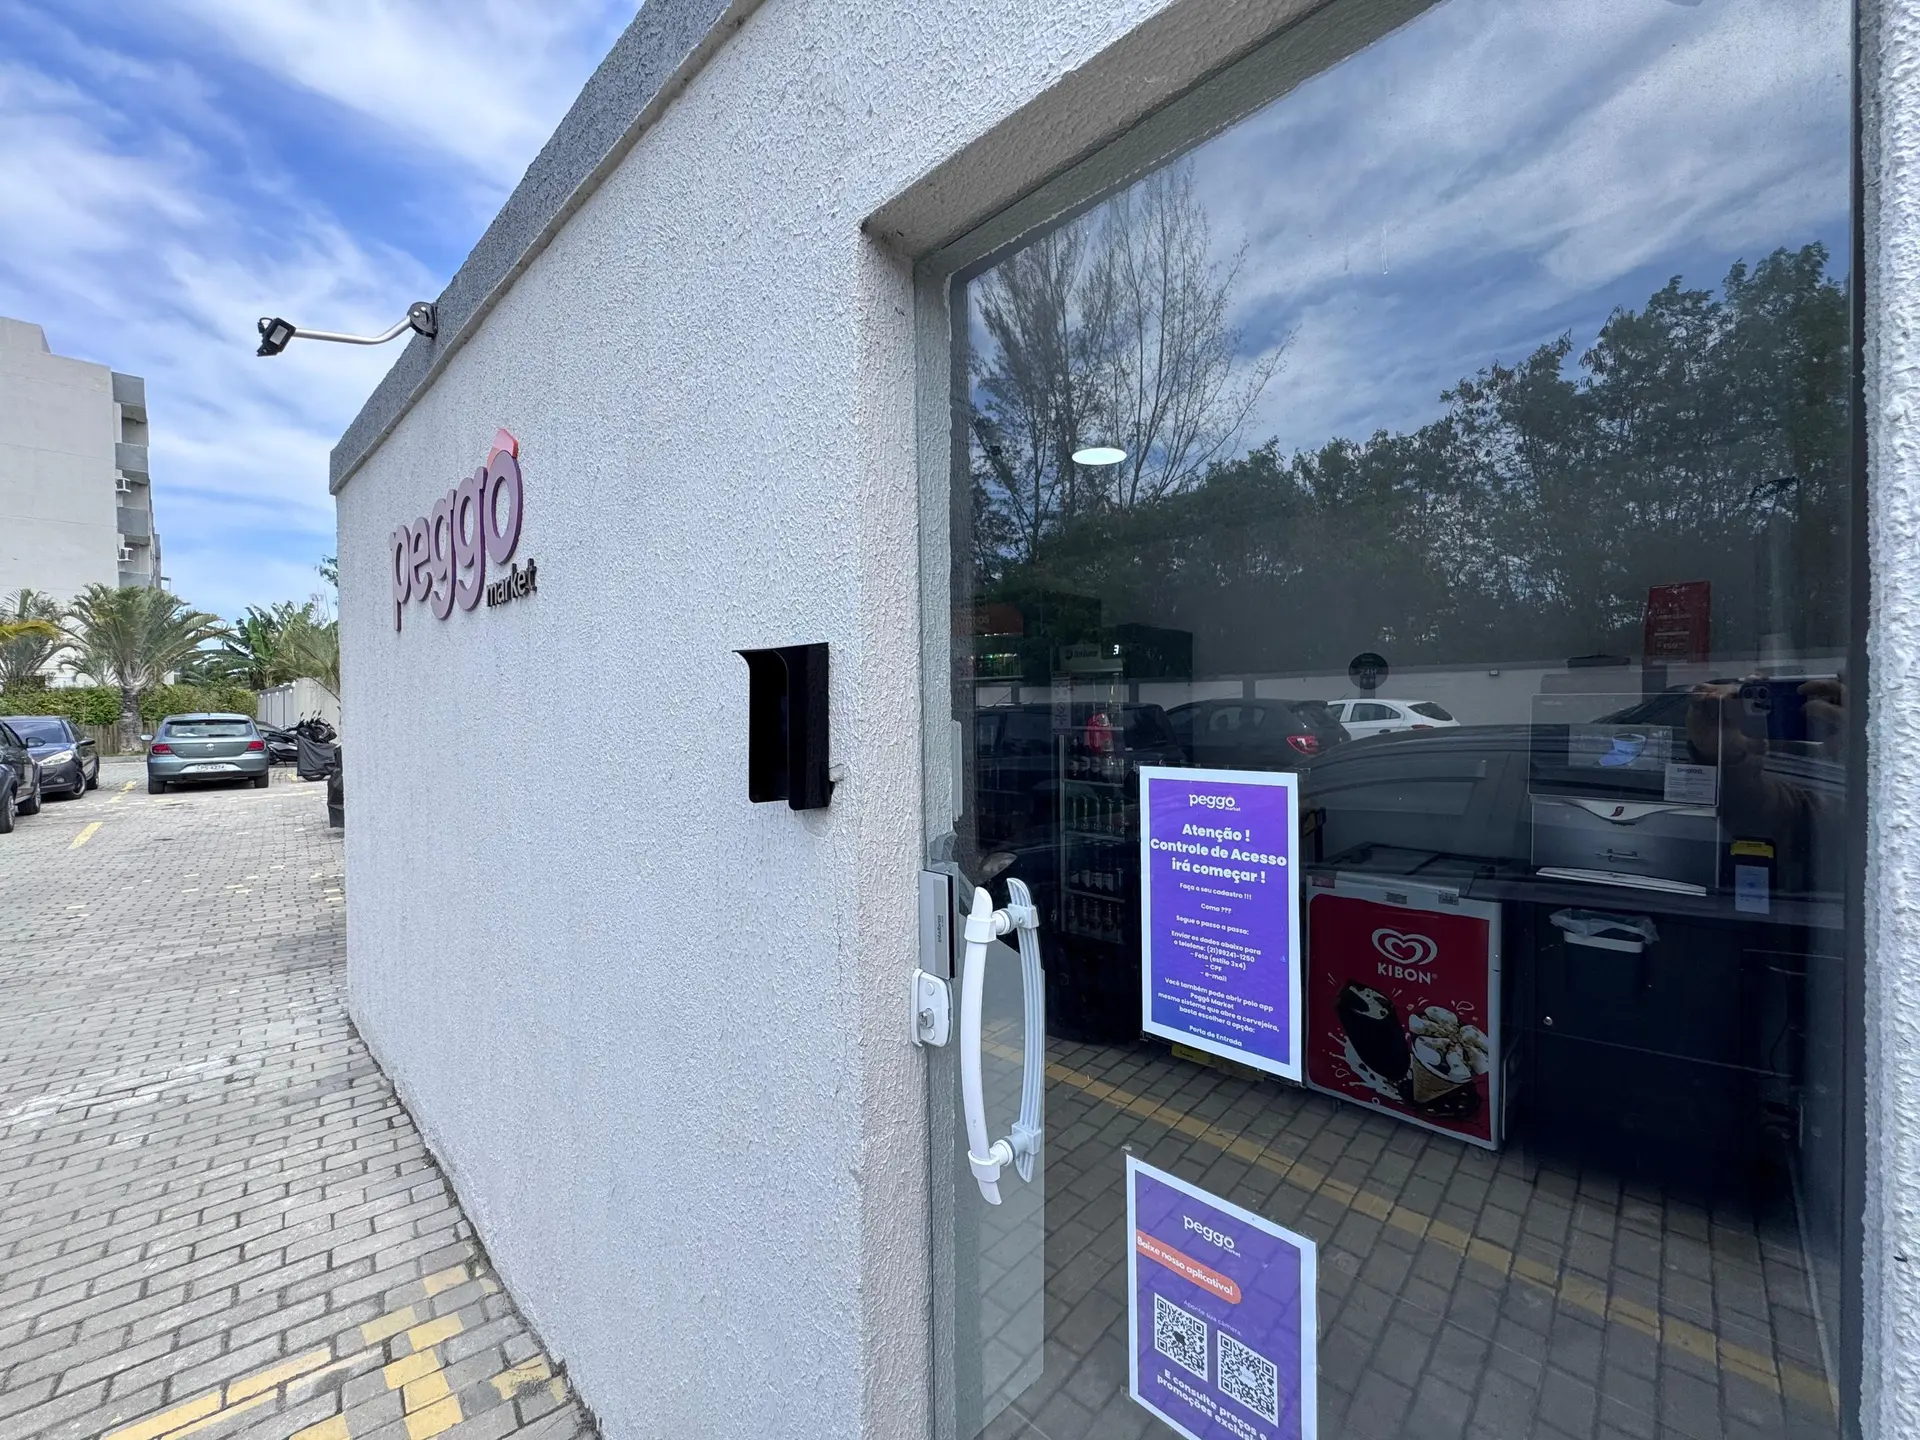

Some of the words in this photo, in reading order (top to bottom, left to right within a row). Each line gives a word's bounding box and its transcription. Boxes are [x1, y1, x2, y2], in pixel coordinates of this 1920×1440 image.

[487, 558, 537, 607] market
[1189, 794, 1236, 809] peggo
[1182, 824, 1242, 842] Atenção
[1245, 829, 1250, 842] !
[1150, 839, 1208, 855] Controle
[1210, 846, 1228, 858] de
[1231, 849, 1286, 866] Acesso
[1172, 857, 1190, 872] irá
[1193, 864, 1257, 883] começar
[1260, 871, 1265, 884] !
[1180, 882, 1195, 891] Faça
[1213, 889, 1243, 898] cadastro
[1201, 903, 1220, 912] Como
[1176, 915, 1195, 924] Segue
[1201, 921, 1220, 929] passo
[1227, 926, 1249, 935] passo:
[1171, 930, 1191, 939] Enviar
[1200, 937, 1220, 946] dados
[1220, 942, 1244, 951] abaixo
[1244, 947, 1261, 955] para
[1179, 940, 1206, 951] telefone:
[1194, 952, 1209, 960] Foto
[1209, 955, 1230, 965] (estilo
[1231, 960, 1246, 970] 3x4)
[1205, 972, 1227, 982] e-mail
[1377, 962, 1431, 985] KIBON
[1158, 992, 1180, 1002] mesmo
[1181, 999, 1206, 1010] sistema
[1220, 1010, 1236, 1019] abre
[1165, 977, 1180, 986] Você
[1180, 982, 1208, 993] também
[1208, 990, 1225, 998] pode
[1226, 994, 1242, 1003] abrir
[1259, 1004, 1273, 1012] app
[1211, 998, 1234, 1009] Market
[1179, 1006, 1197, 1016] basta
[1198, 1012, 1225, 1024] escolher
[1232, 1022, 1255, 1033] opção:
[1189, 1025, 1206, 1035] Porta
[1216, 1034, 1242, 1046] Entrada
[1137, 1236, 1160, 1255] Baixe
[1161, 1251, 1185, 1270] nosso
[1186, 1266, 1233, 1296] aplicativo!
[1157, 1374, 1213, 1417] promoções
[1164, 1369, 1171, 1380] E
[1172, 1376, 1217, 1410] consulte
[1220, 1407, 1257, 1436] preços
